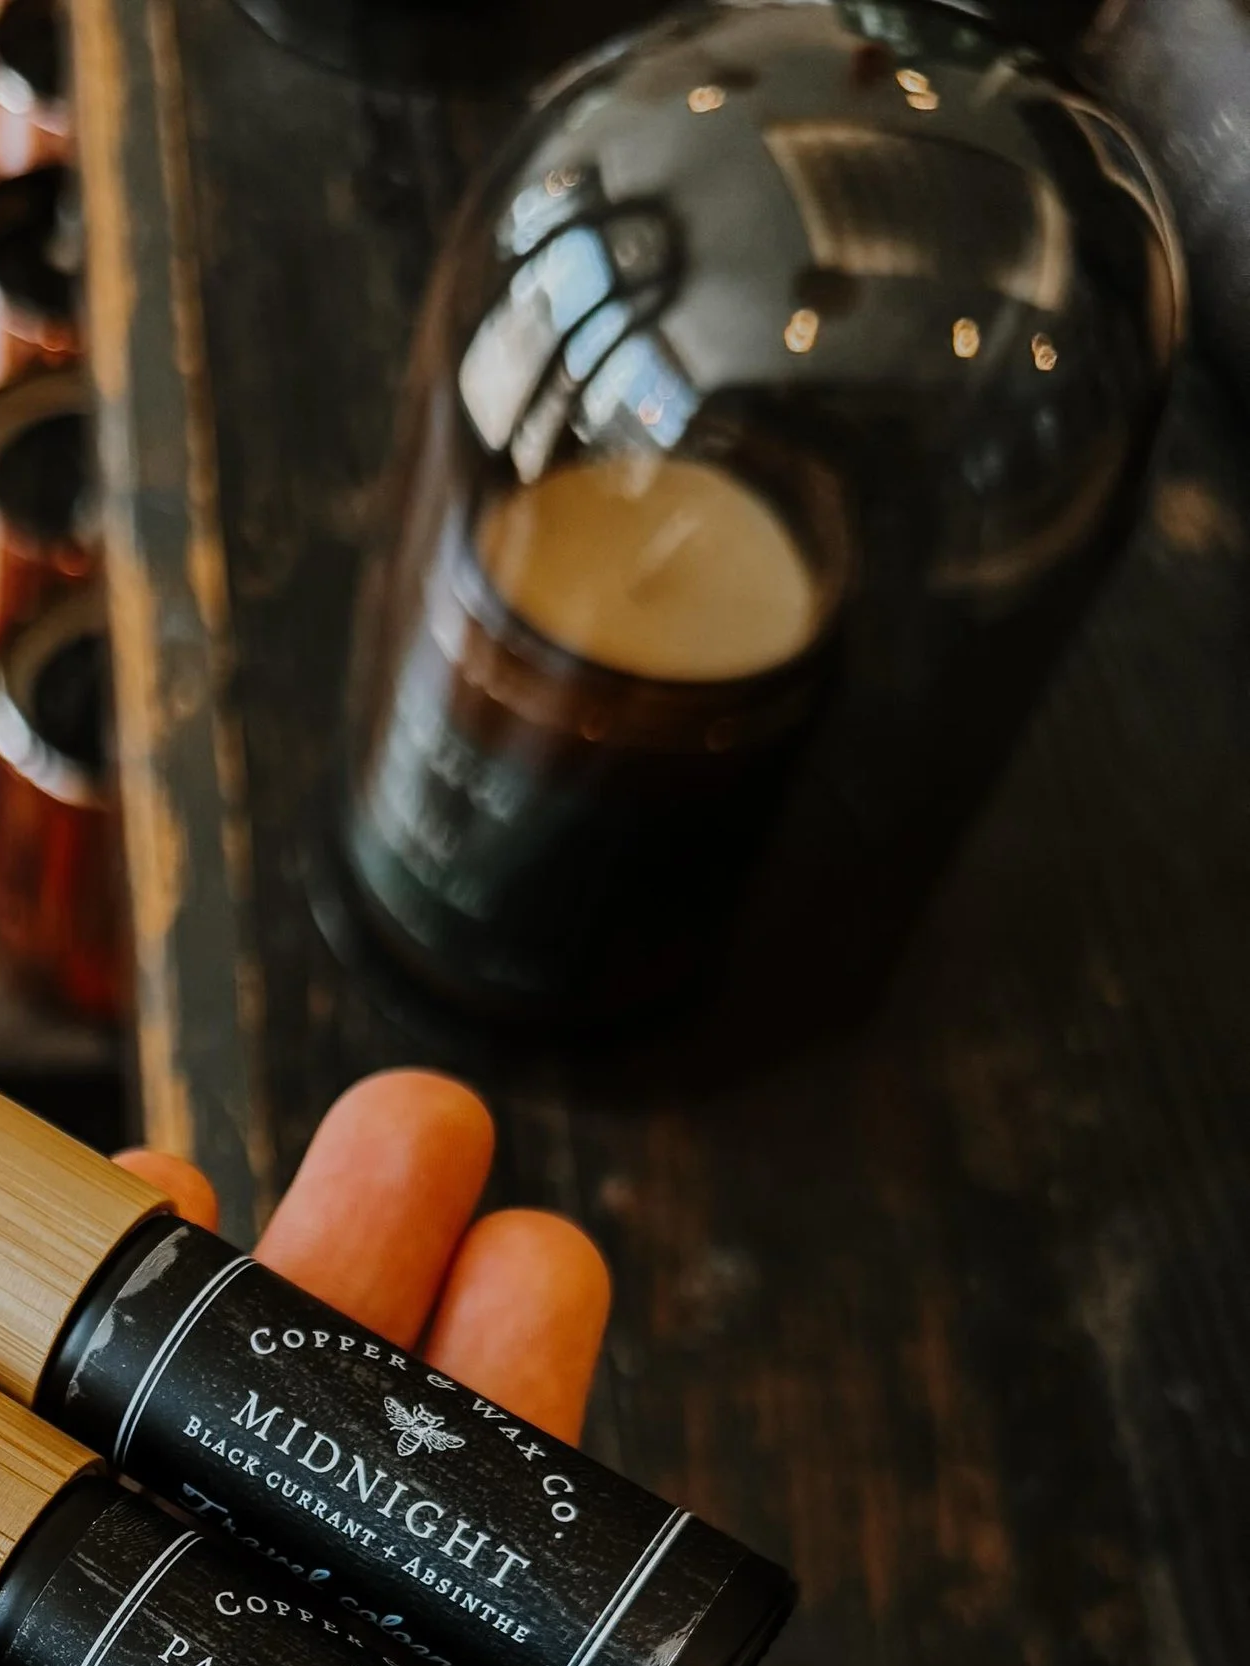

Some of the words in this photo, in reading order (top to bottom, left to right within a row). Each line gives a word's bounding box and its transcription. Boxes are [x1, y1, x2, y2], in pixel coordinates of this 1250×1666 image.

[184, 1416, 260, 1477] BLACK
[266, 1471, 377, 1546] CURRANT
[401, 1556, 533, 1644] ABSINTHE
[230, 1389, 531, 1589] MIDNIGHT
[250, 1327, 408, 1371] COPPER
[427, 1372, 457, 1391] &
[472, 1397, 548, 1462] WAX
[542, 1474, 580, 1540] CO.
